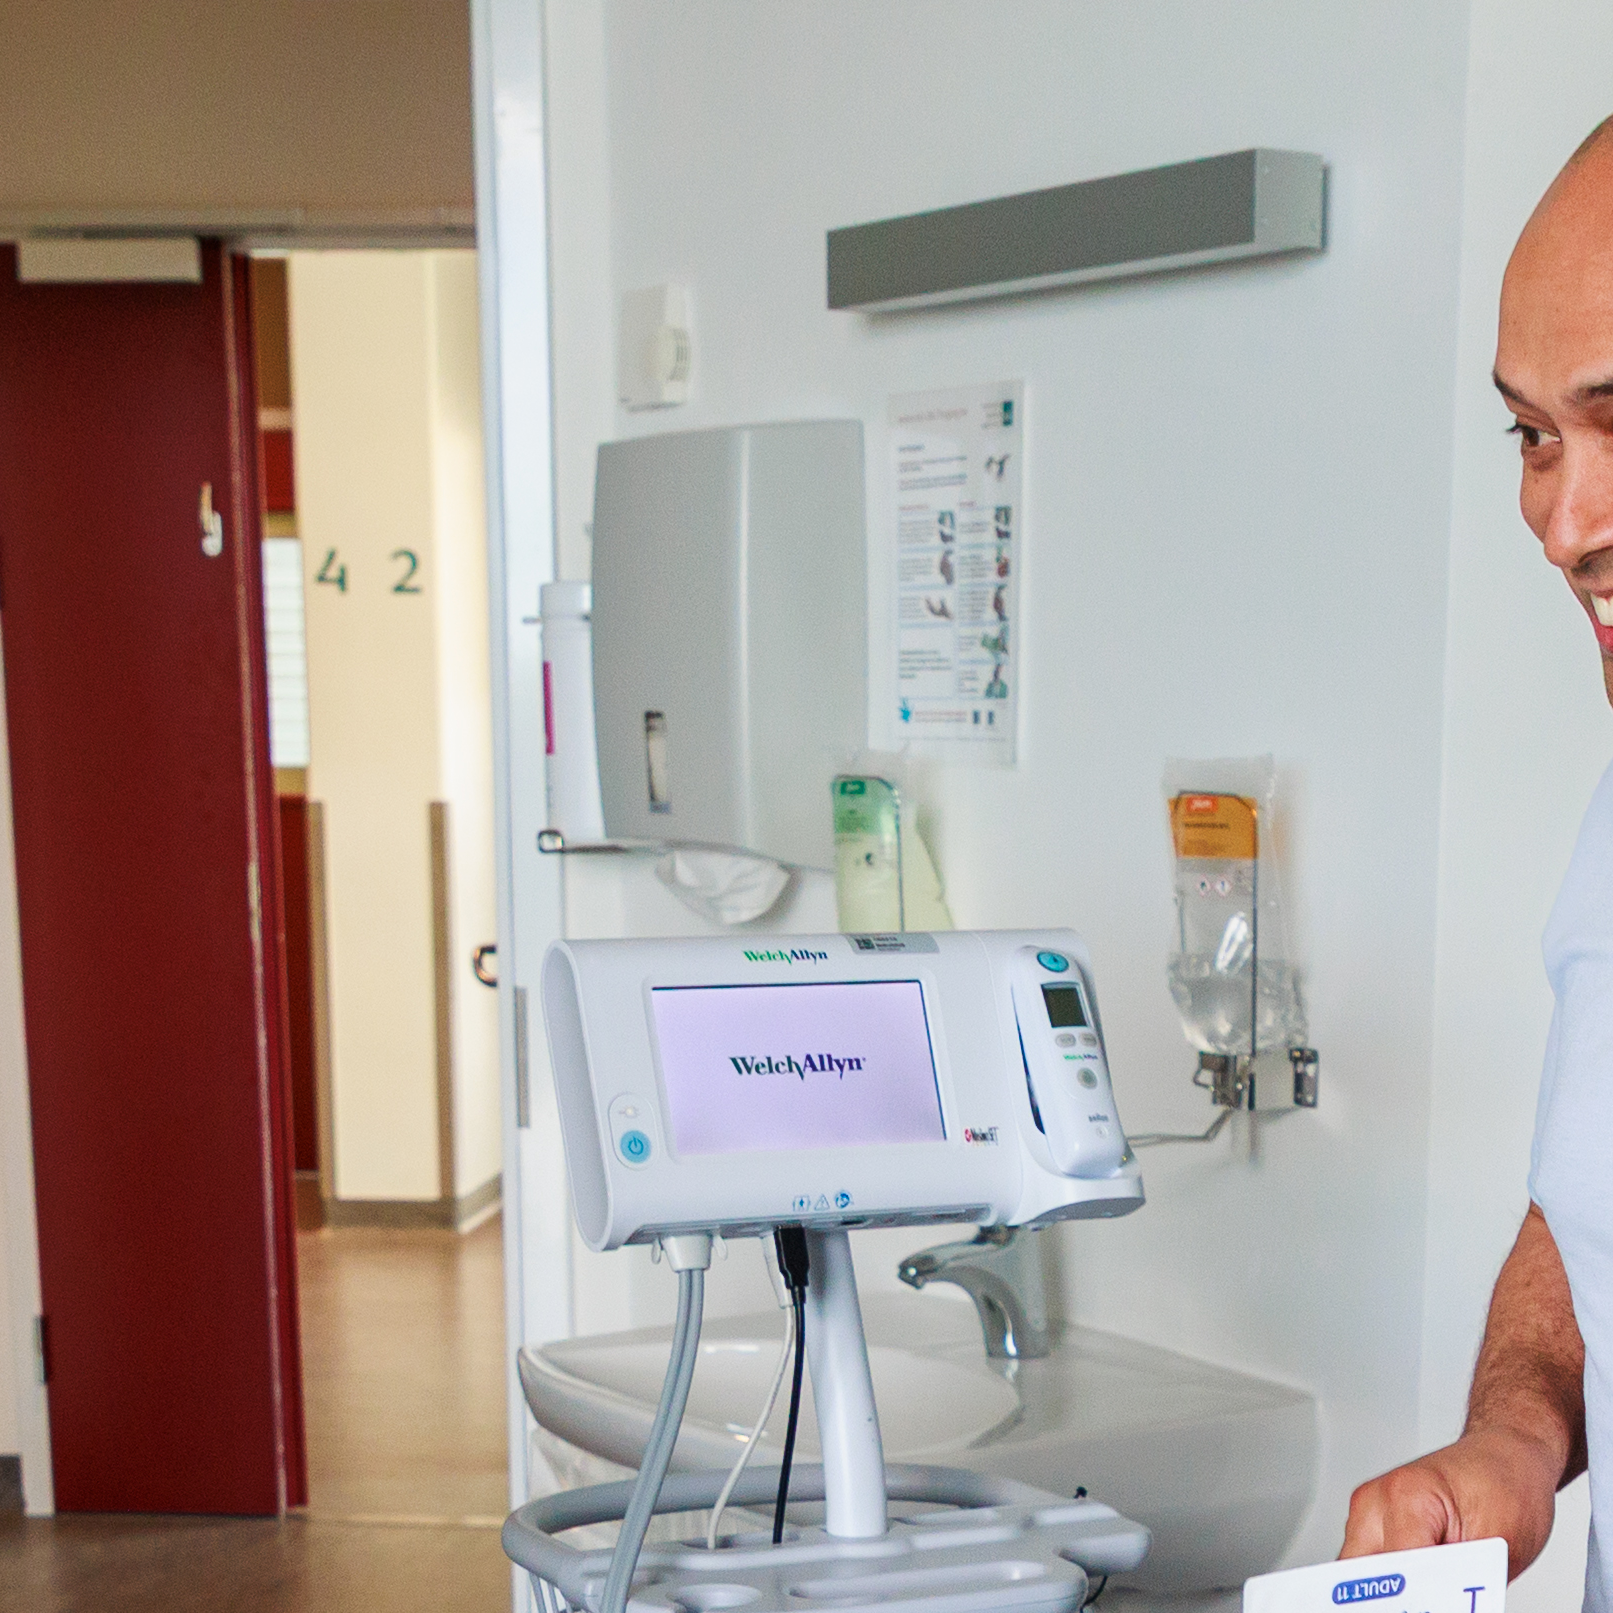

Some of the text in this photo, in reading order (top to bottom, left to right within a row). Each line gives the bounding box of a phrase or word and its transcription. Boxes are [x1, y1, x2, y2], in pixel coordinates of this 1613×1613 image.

[316, 548, 422, 594] 4 2
[1337, 1577, 1401, 1601] ADULT 11
